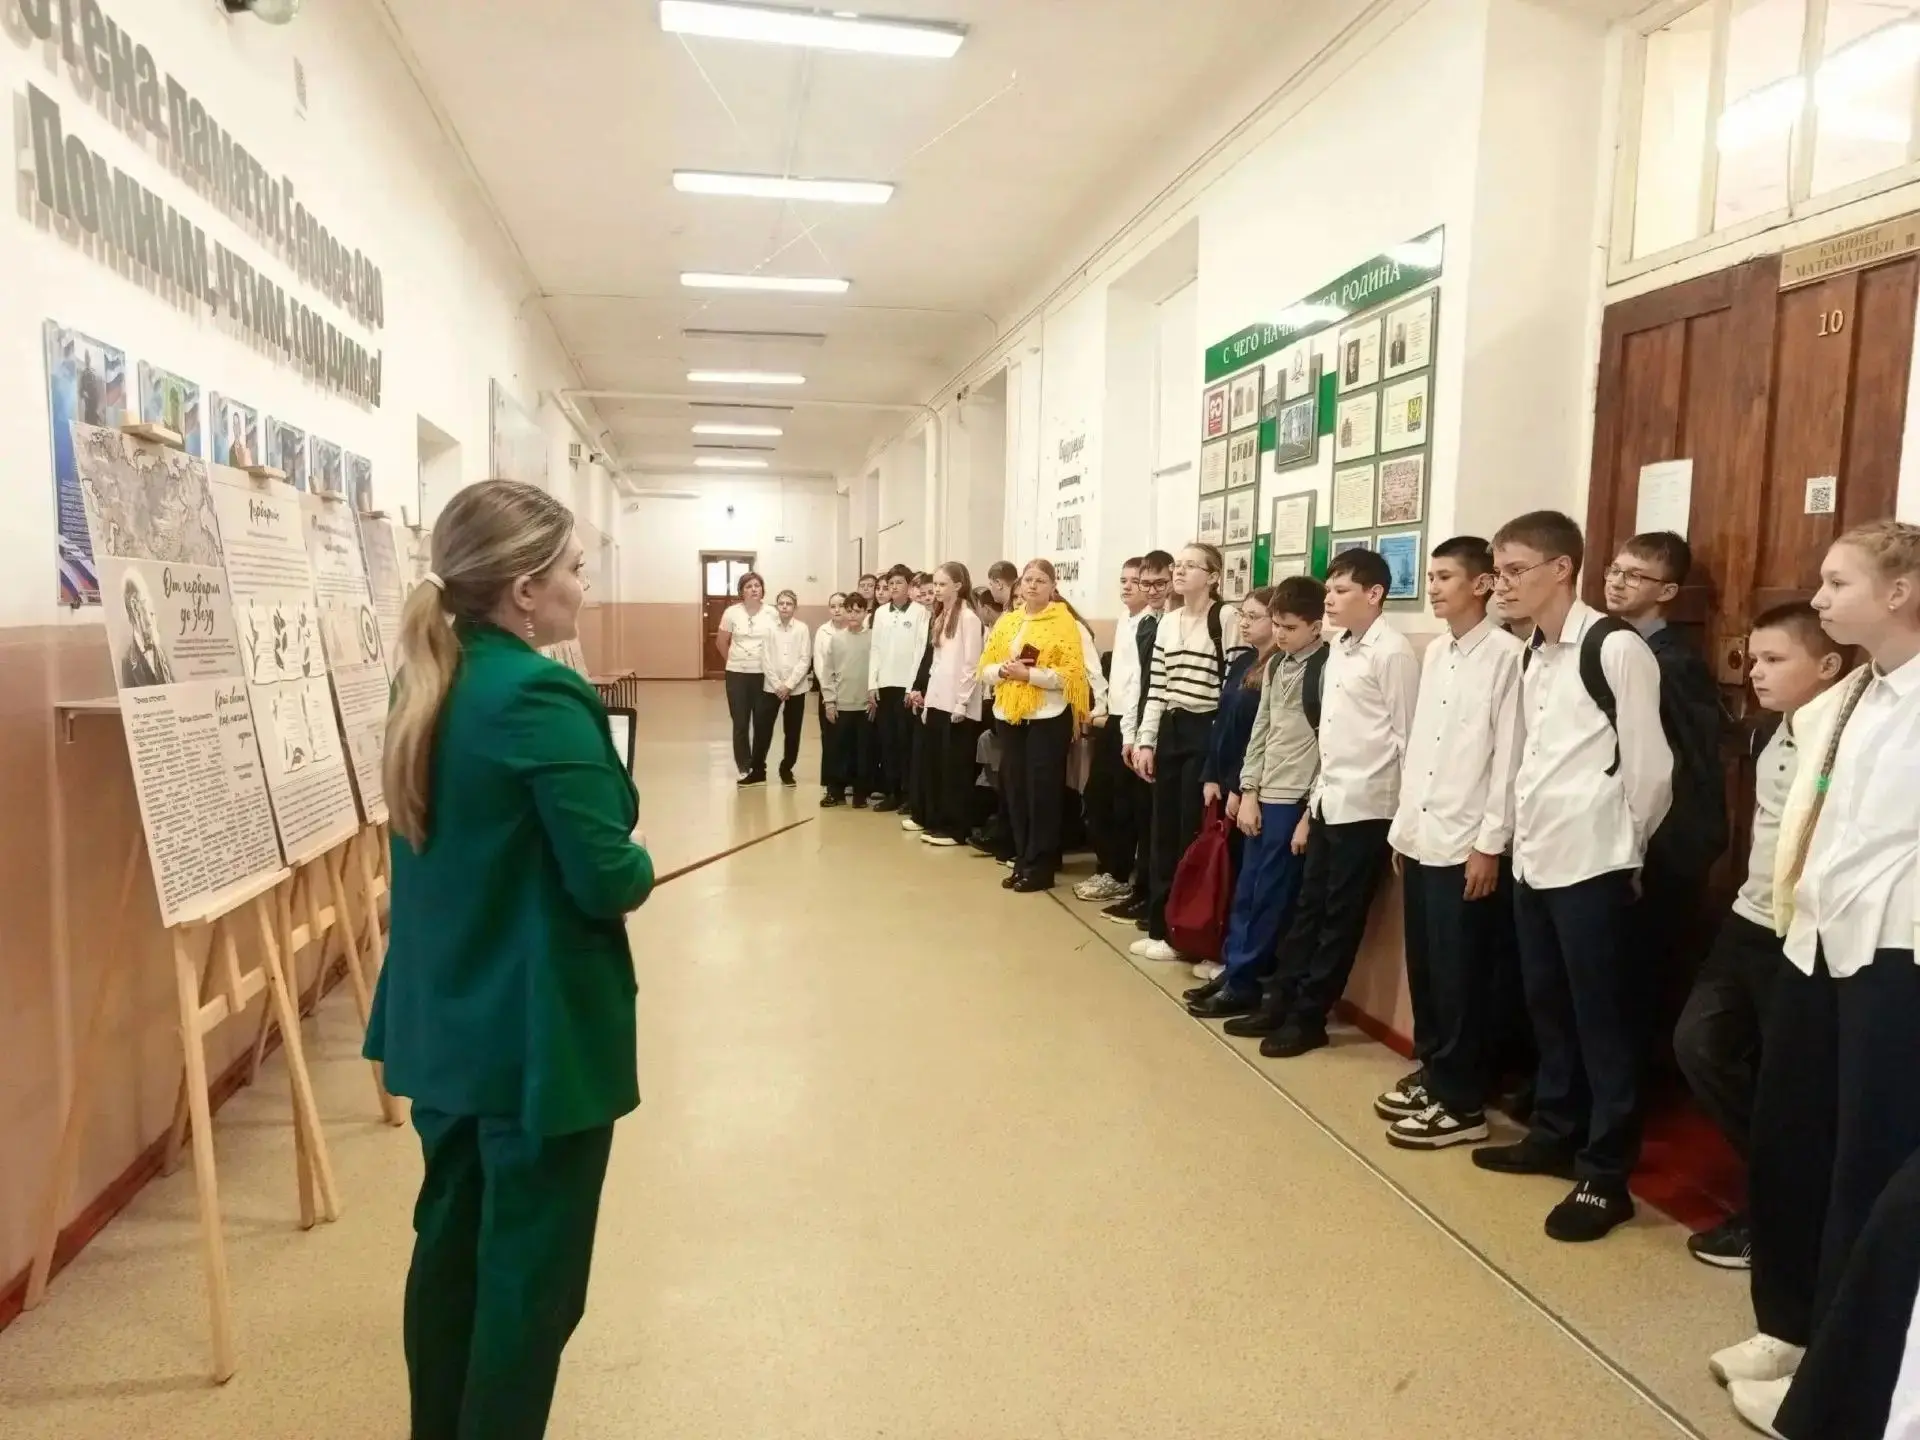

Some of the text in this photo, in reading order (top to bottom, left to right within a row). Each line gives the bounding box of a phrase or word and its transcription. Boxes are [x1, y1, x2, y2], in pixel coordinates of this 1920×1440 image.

[165, 72, 284, 246] памяти
[1233, 332, 1259, 359] ЧЕГО
[1342, 262, 1402, 306] РОДИНА
[1817, 308, 1844, 337] 10
[163, 567, 182, 598] От
[1576, 1193, 1608, 1209] NIKE
